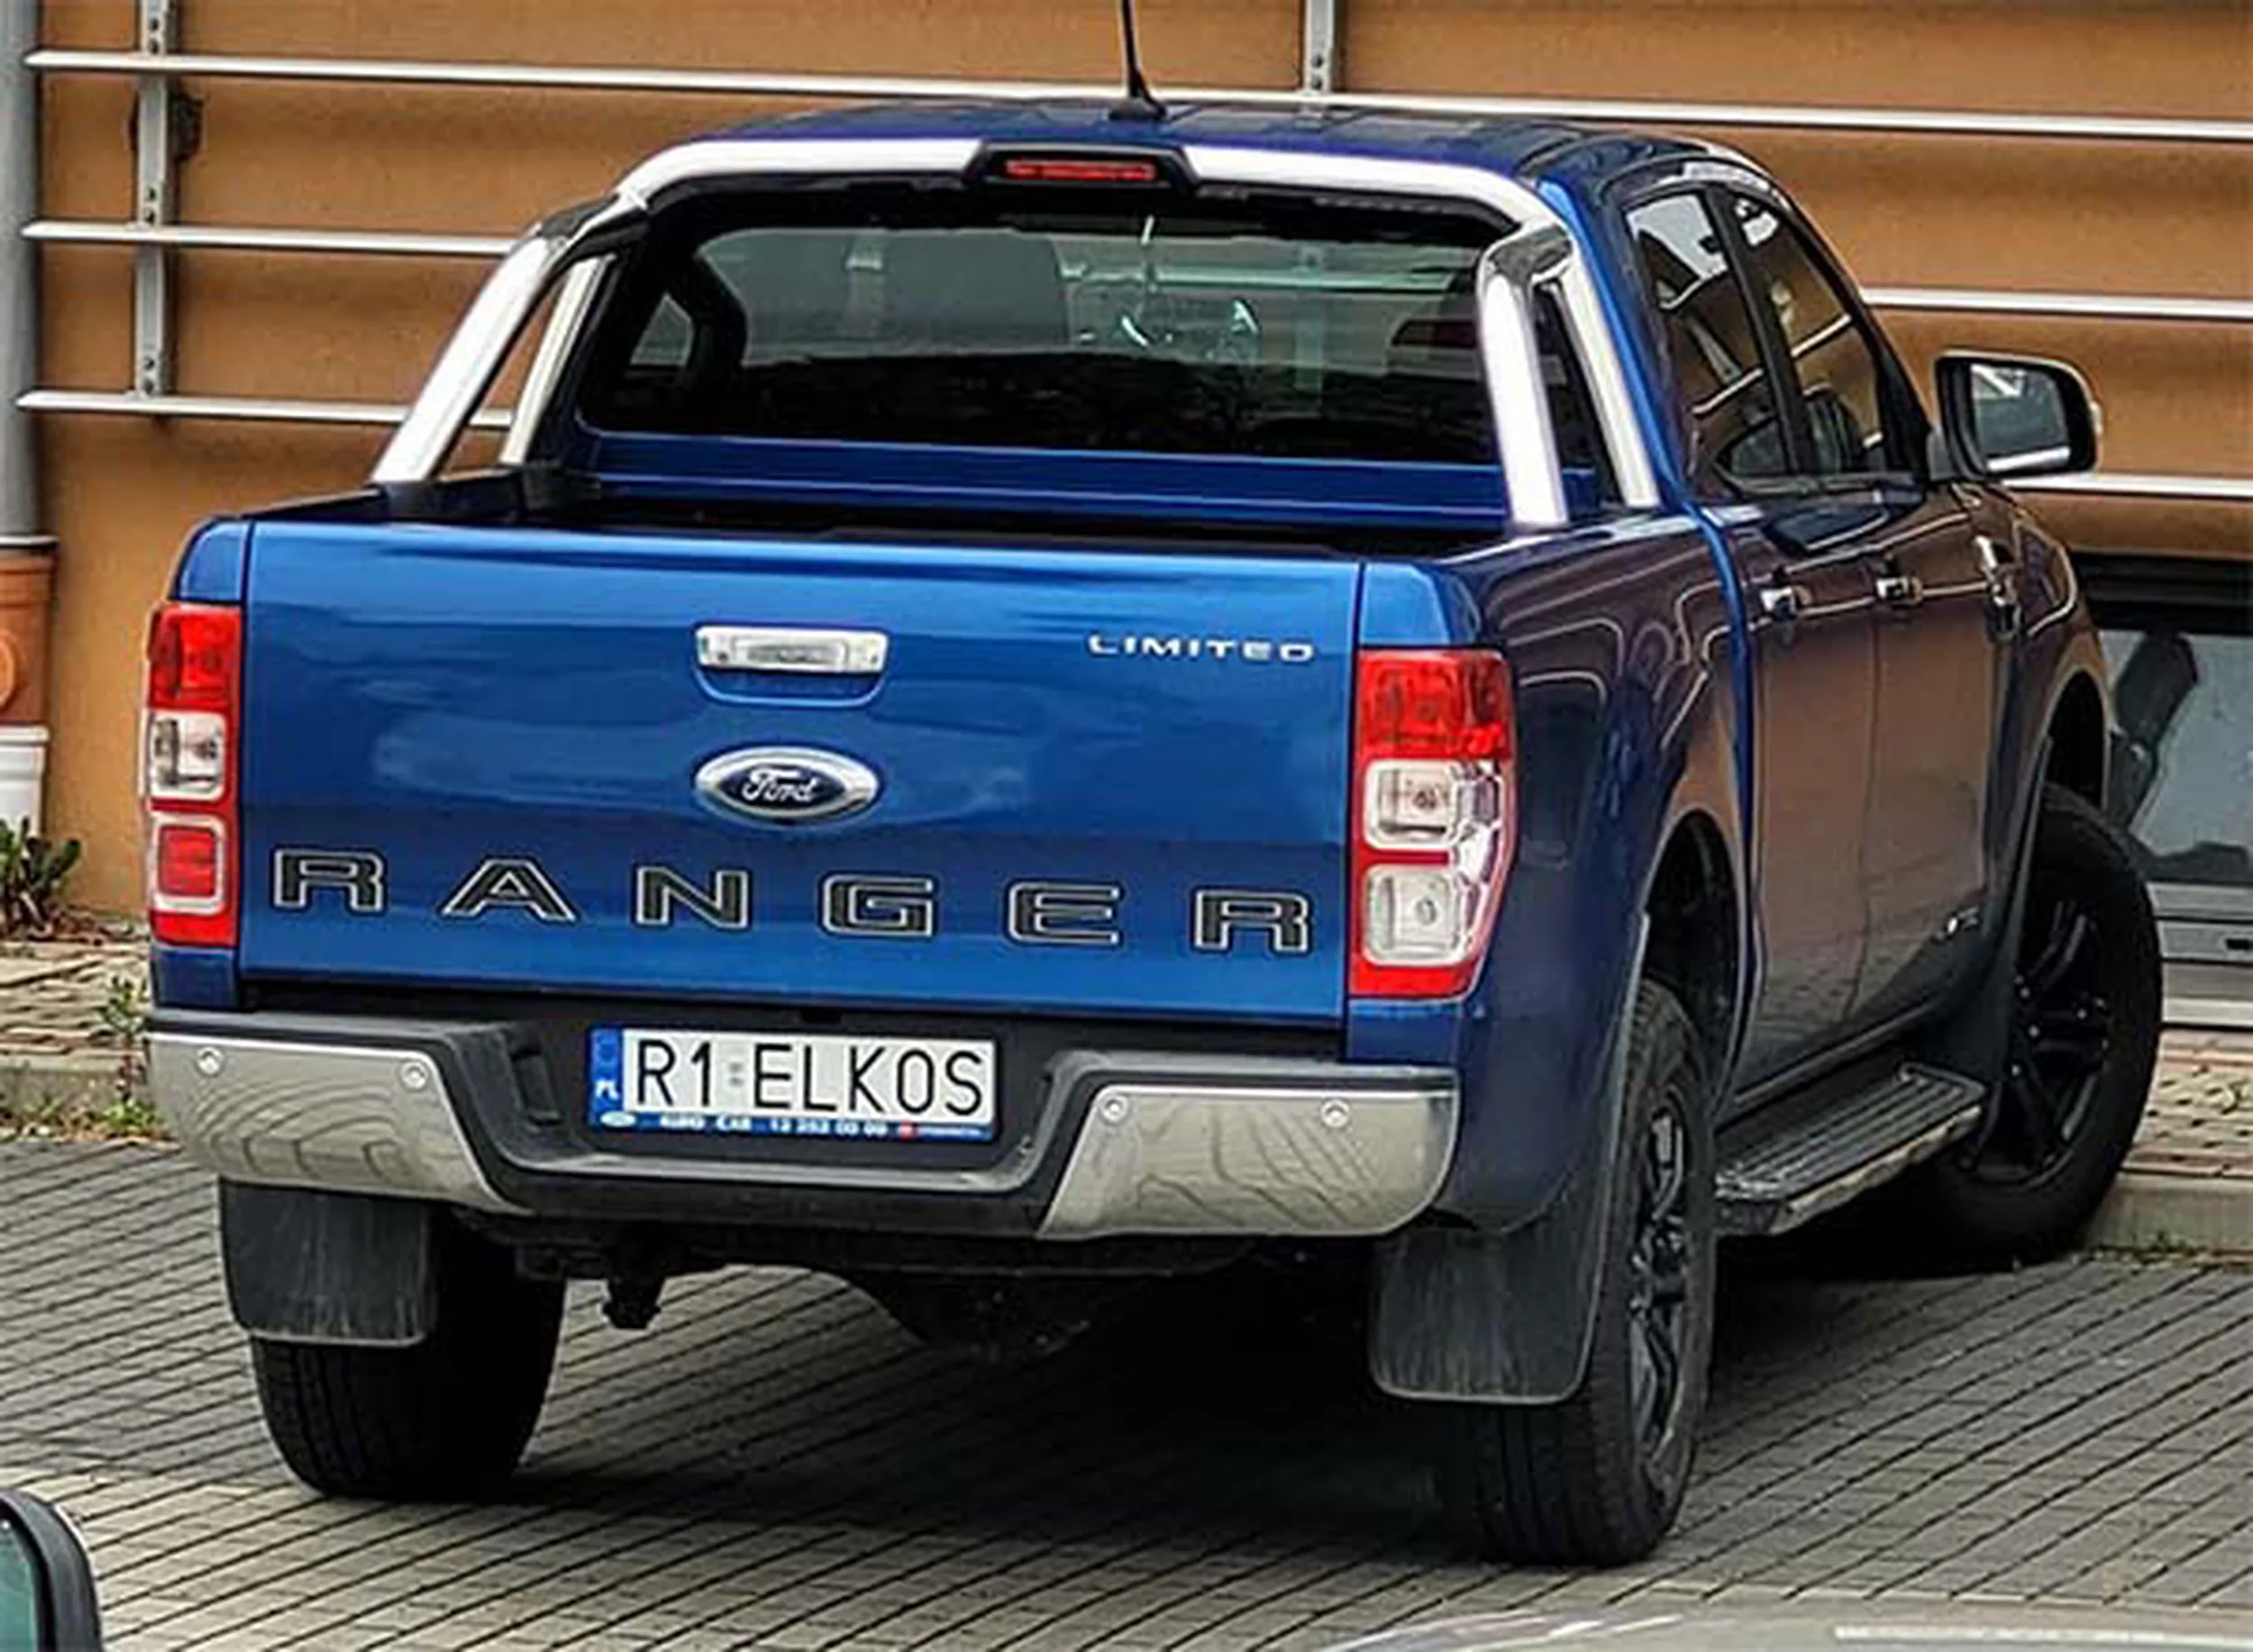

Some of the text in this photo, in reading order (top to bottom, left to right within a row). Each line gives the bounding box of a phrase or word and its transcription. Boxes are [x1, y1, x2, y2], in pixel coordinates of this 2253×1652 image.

[1088, 633, 1315, 662] LIMITED
[742, 767, 818, 802] Ford
[274, 849, 1309, 954] RANGER
[637, 1038, 712, 1108] R1
